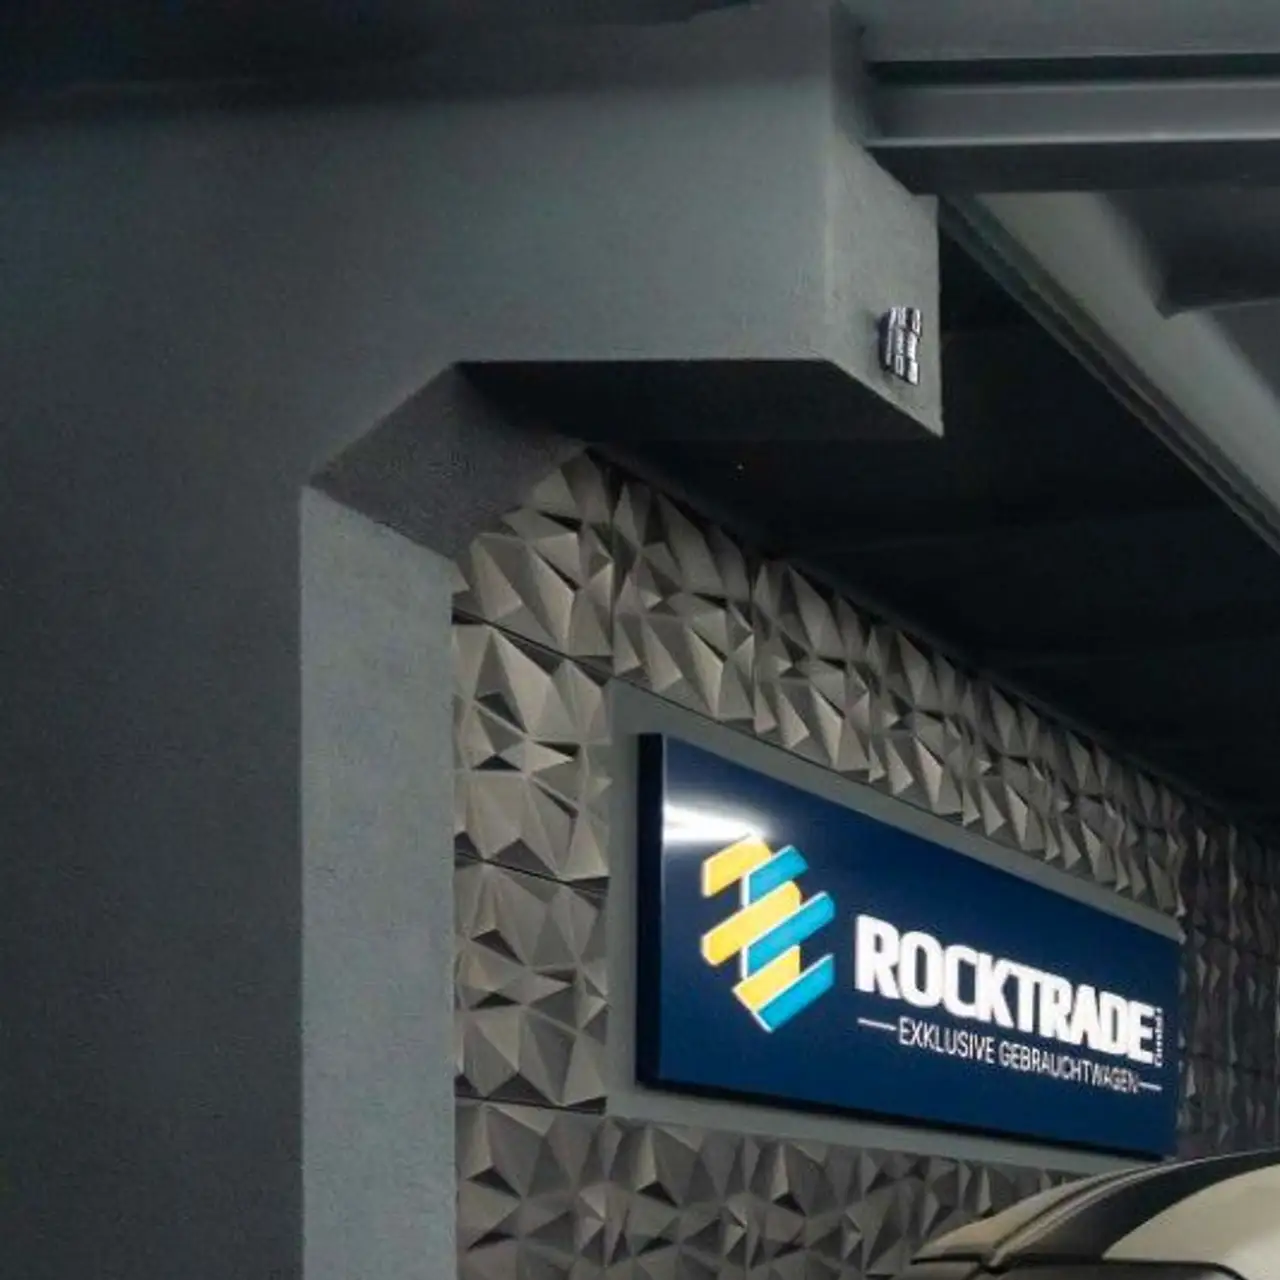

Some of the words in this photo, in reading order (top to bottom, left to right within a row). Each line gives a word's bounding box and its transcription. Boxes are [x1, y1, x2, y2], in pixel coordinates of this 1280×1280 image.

[855, 913, 1155, 1066] ROCKTRADE
[898, 1016, 995, 1064] EXKLUSIVE
[999, 1039, 1139, 1094] GEBRAUCHTWAGEN
